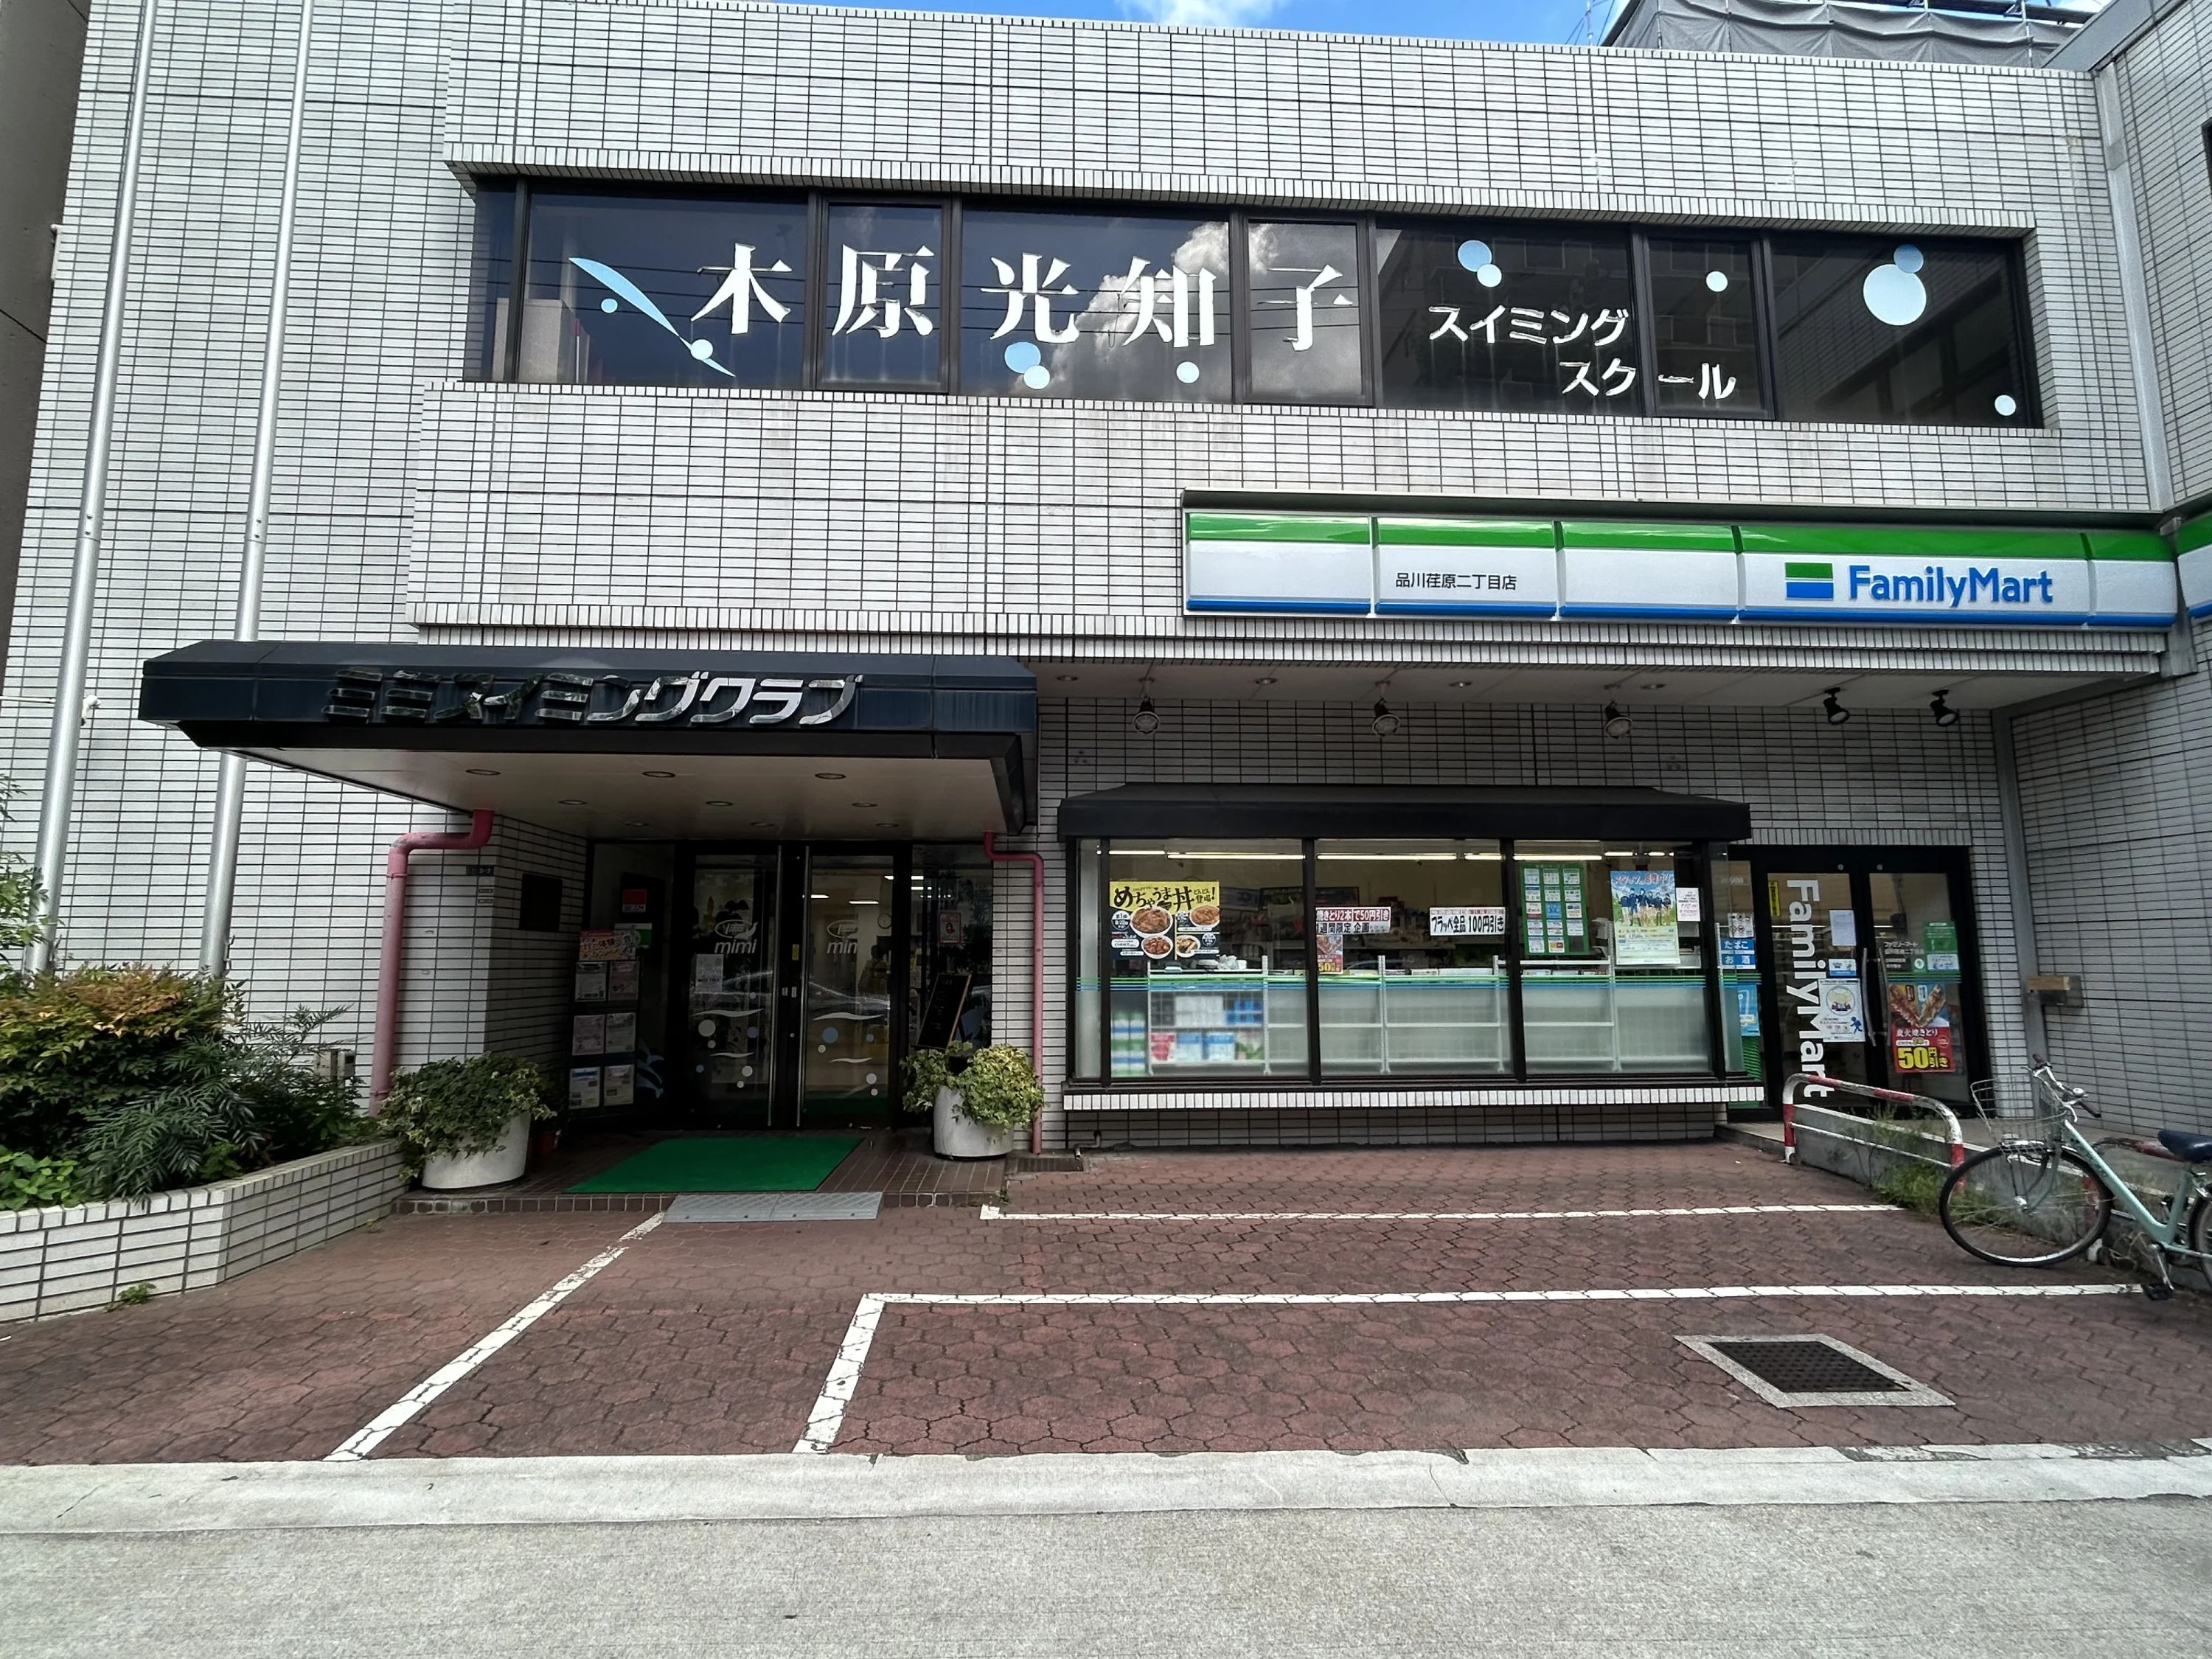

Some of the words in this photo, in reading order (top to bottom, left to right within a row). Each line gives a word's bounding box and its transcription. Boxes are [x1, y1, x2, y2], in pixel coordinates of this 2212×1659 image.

[690, 243, 1355, 352] 木原光知子
[1428, 304, 1630, 348] スイミング
[1559, 359, 1737, 401] スクール
[1395, 572, 1517, 590] 品川荏原二丁目店
[1848, 564, 2054, 608] FamilyMart
[321, 667, 863, 726] ミミスイミングクラブ
[1114, 886, 1194, 912] めちゃうま丼
[1468, 915, 1504, 933] 100円引き
[1724, 940, 1750, 950] たばこ
[714, 939, 758, 954] mimi
[1786, 880, 1835, 1098] FamilyMart
